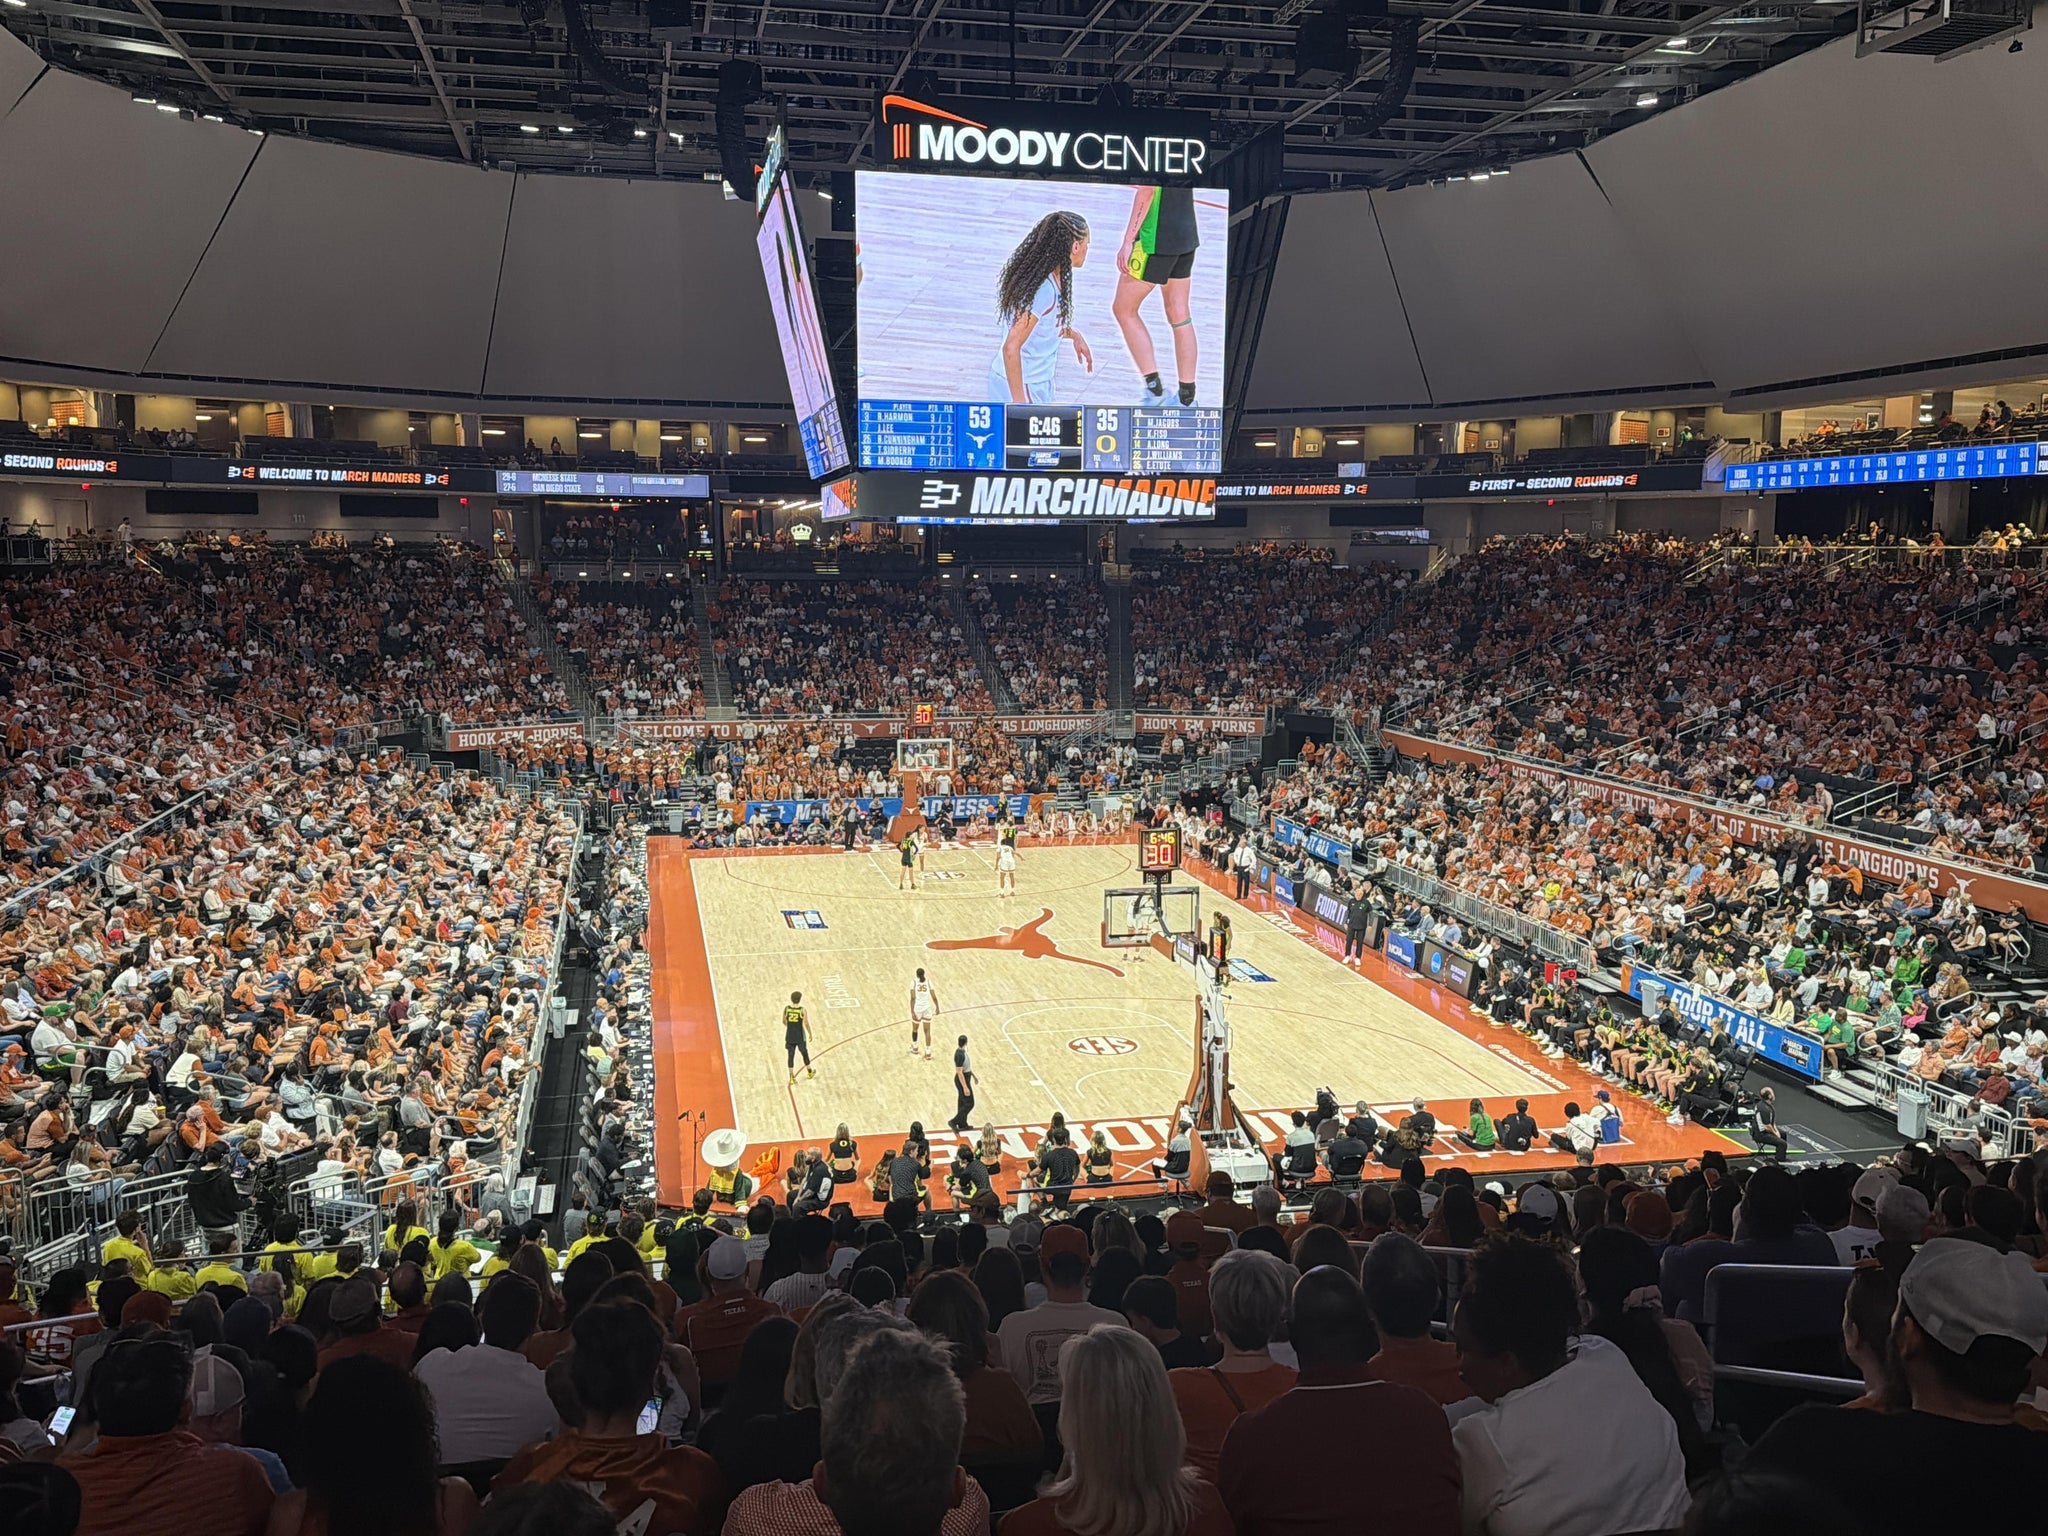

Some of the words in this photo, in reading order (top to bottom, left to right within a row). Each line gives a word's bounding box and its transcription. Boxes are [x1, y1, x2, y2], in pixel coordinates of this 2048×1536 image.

[919, 124, 1070, 167] MOODY
[1074, 132, 1206, 174] CENTER
[969, 406, 990, 429] 53
[1029, 416, 1060, 436] 6:46
[1096, 409, 1118, 431] 35
[4, 454, 53, 470] SECOND
[56, 458, 104, 472] ROUNDS
[259, 467, 312, 480] WELCOME
[315, 469, 328, 481] TO
[331, 470, 369, 482] MARCH
[372, 472, 421, 484] MADNESS
[560, 474, 577, 482] STATE
[1481, 479, 1516, 490] FIRST
[1526, 477, 1573, 489] SECOND
[1574, 475, 1624, 488] ROUNDS
[532, 483, 545, 492] SAN
[546, 484, 563, 492] DIEGO
[564, 484, 581, 493] STATE
[969, 477, 1215, 516] MARCHMADNE
[1244, 486, 1256, 495] TO
[1258, 485, 1292, 495] MARCH
[1294, 484, 1341, 495] MADNESS
[633, 725, 705, 738] ELCOME
[711, 724, 729, 737] TO
[1021, 718, 1093, 732] LONGHORNS
[1143, 717, 1177, 730] HOOK
[1212, 720, 1256, 733] HORNS
[458, 732, 496, 747] HOOK
[533, 727, 577, 742] HORNS
[1729, 818, 1746, 838] OF
[1150, 832, 1176, 844] 6:46
[1147, 844, 1172, 865] 30
[1315, 839, 1330, 858] ALL
[1315, 893, 1339, 922] FOUR
[1335, 903, 1348, 925] IT
[917, 984, 927, 993] 35
[788, 1013, 799, 1022] 22
[1670, 988, 1714, 1025] FOUR
[1717, 1006, 1736, 1034] IT
[1735, 1017, 1767, 1051] ALL
[723, 1306, 746, 1317] TEXAS
[31, 1325, 73, 1360] 35
